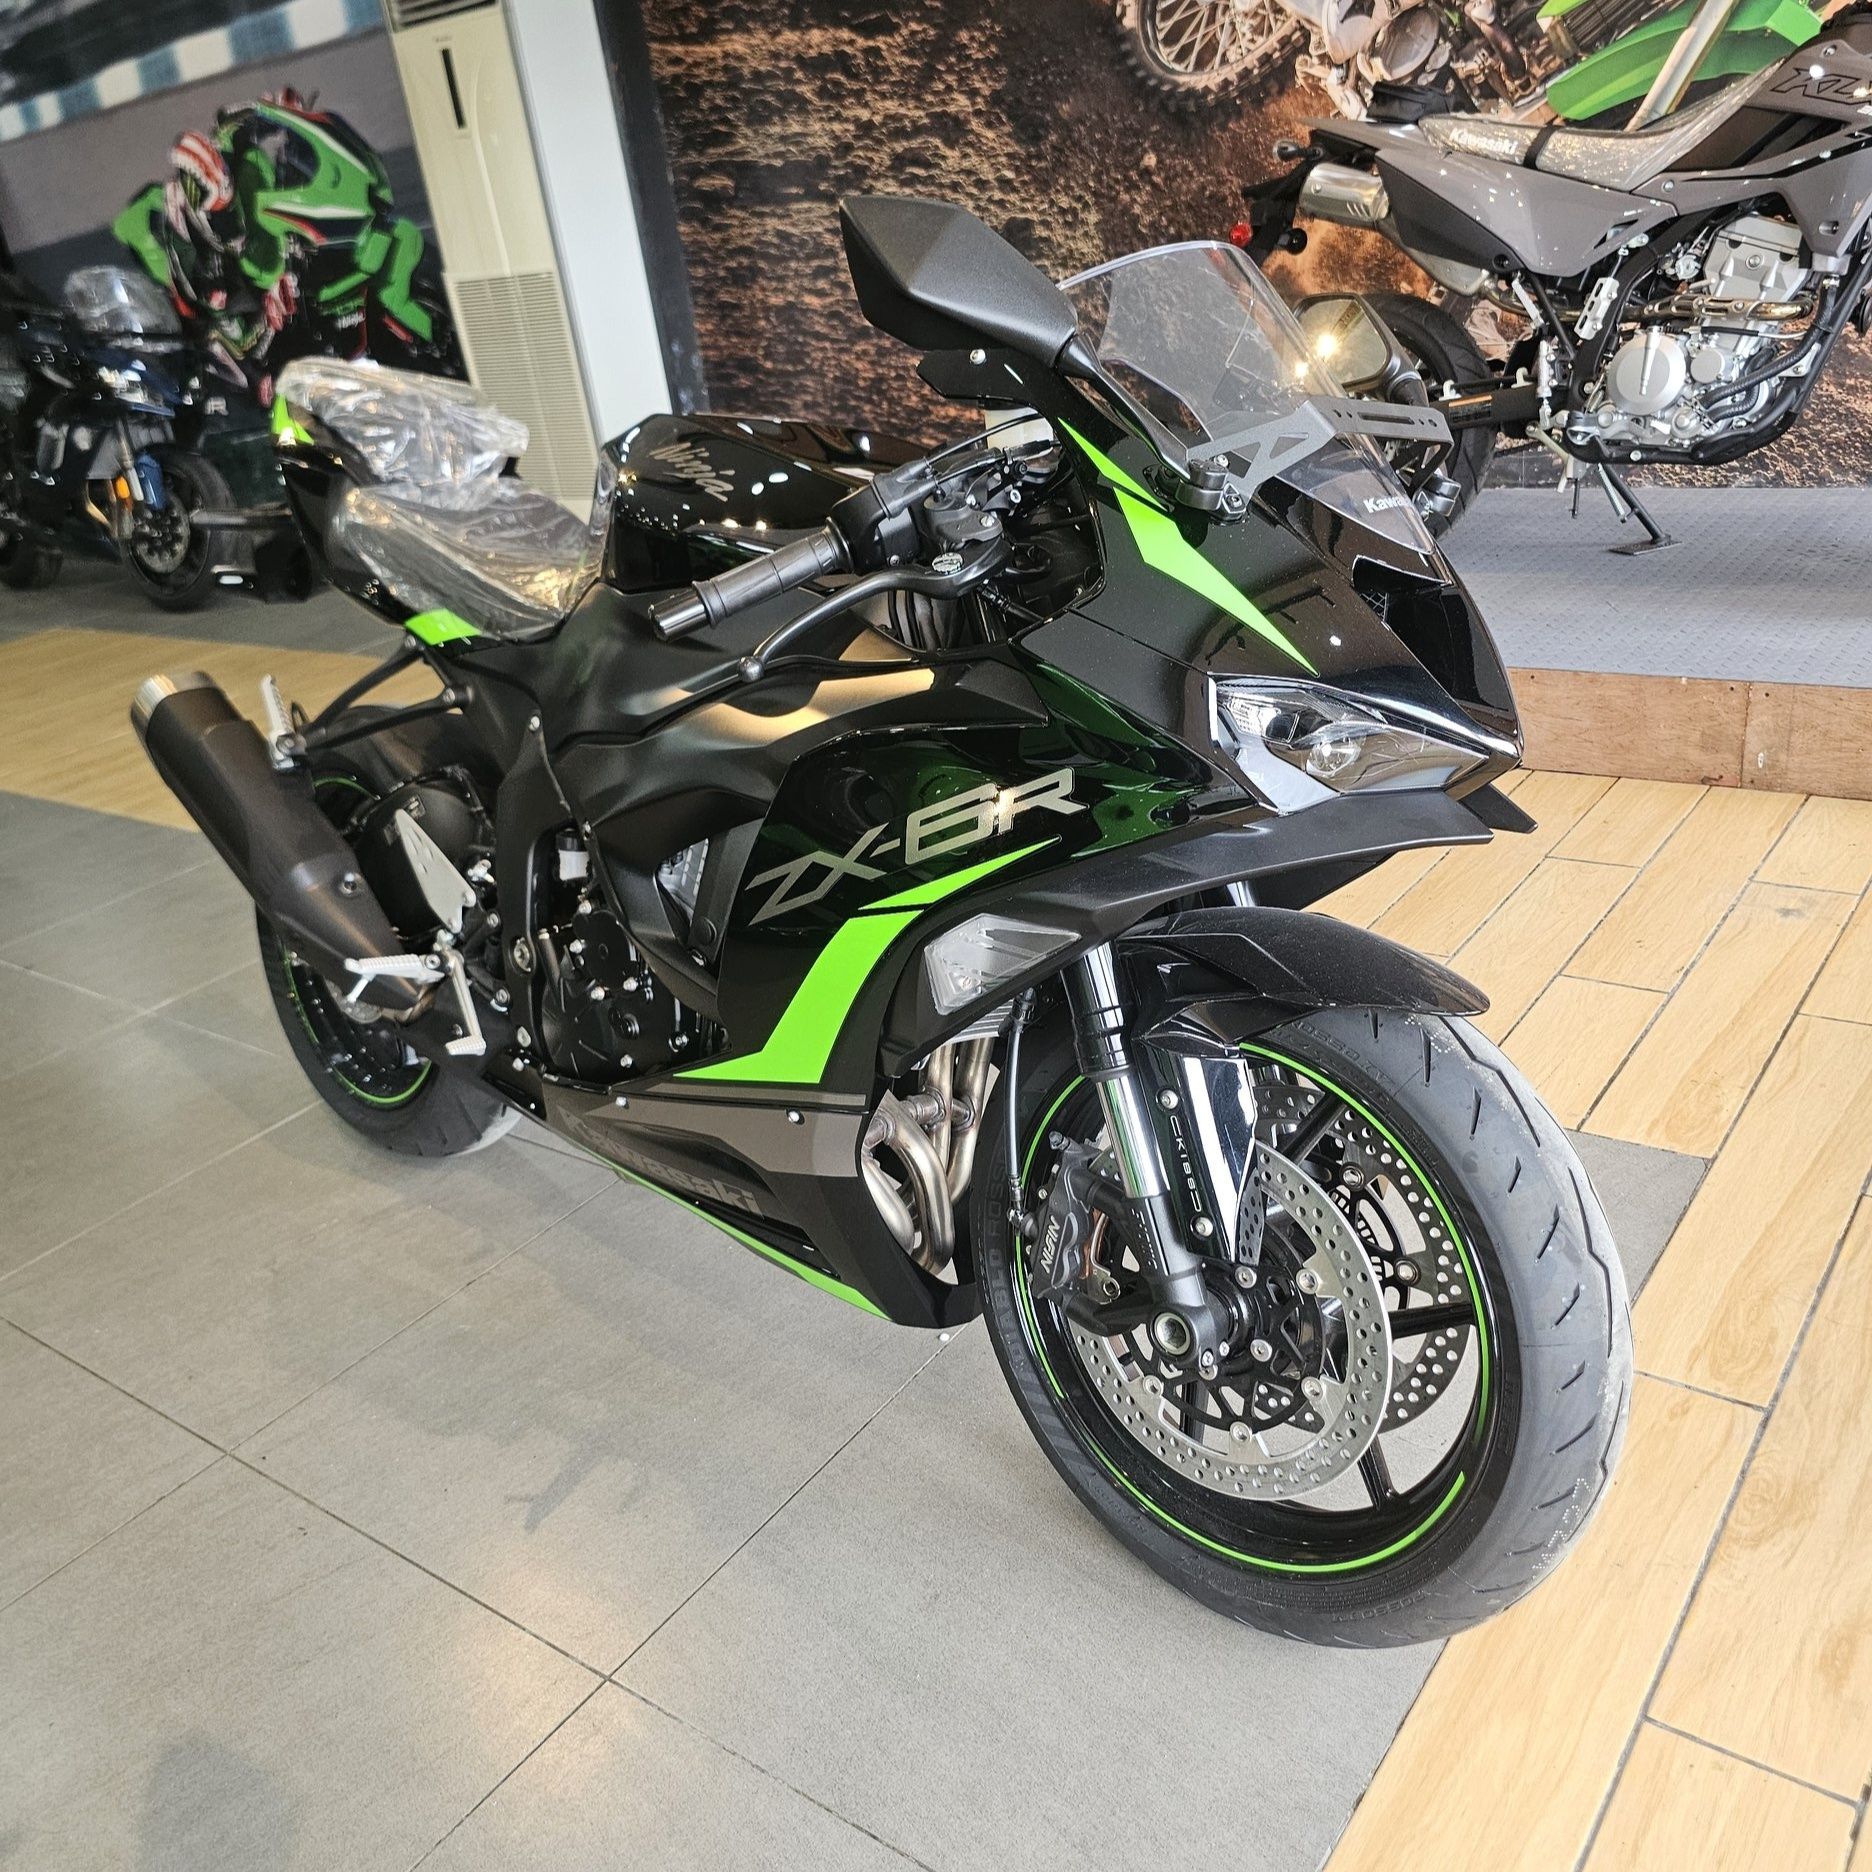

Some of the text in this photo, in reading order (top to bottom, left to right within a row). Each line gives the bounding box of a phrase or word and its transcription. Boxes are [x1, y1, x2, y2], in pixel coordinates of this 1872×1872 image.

[1768, 67, 1872, 106] KL
[1449, 127, 1519, 155] Kawasaki
[649, 442, 735, 502] Ninja
[744, 767, 1090, 926] ZX-6R
[556, 1105, 765, 1221] Kawasaki
